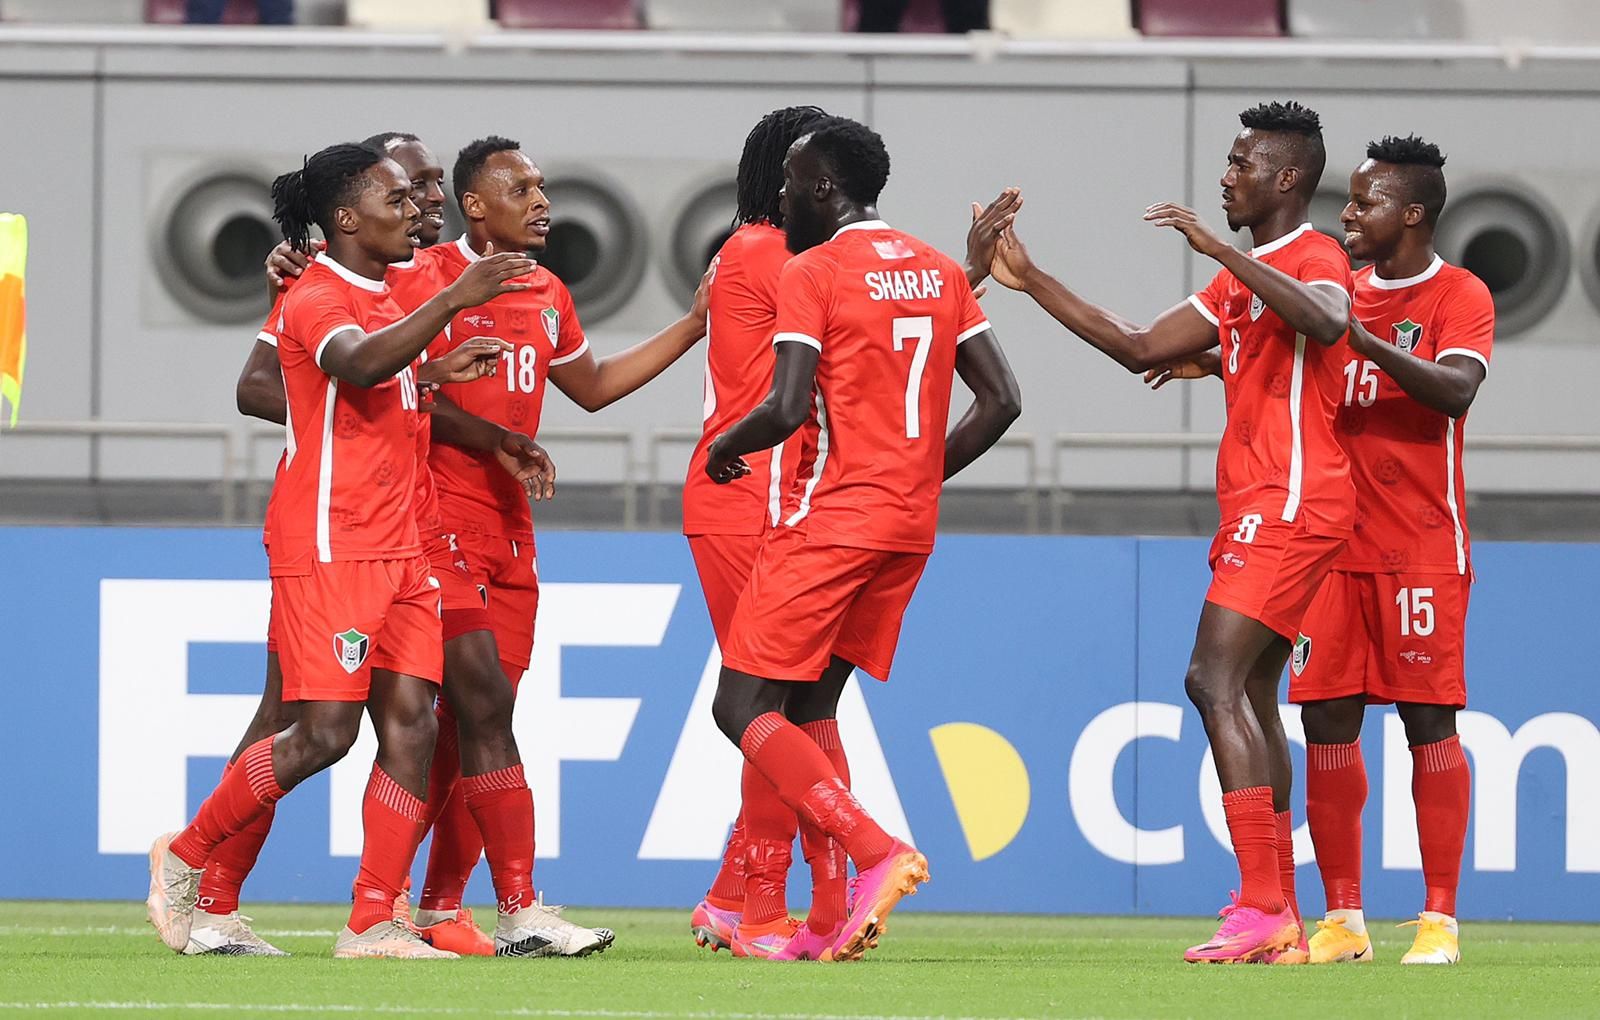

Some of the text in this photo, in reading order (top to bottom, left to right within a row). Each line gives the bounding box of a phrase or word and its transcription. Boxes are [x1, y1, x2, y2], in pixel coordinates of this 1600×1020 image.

[864, 269, 944, 301] SHARAF
[502, 344, 536, 394] 18
[892, 315, 933, 439] 7
[1344, 359, 1381, 407] 15
[1395, 587, 1436, 636] 15
